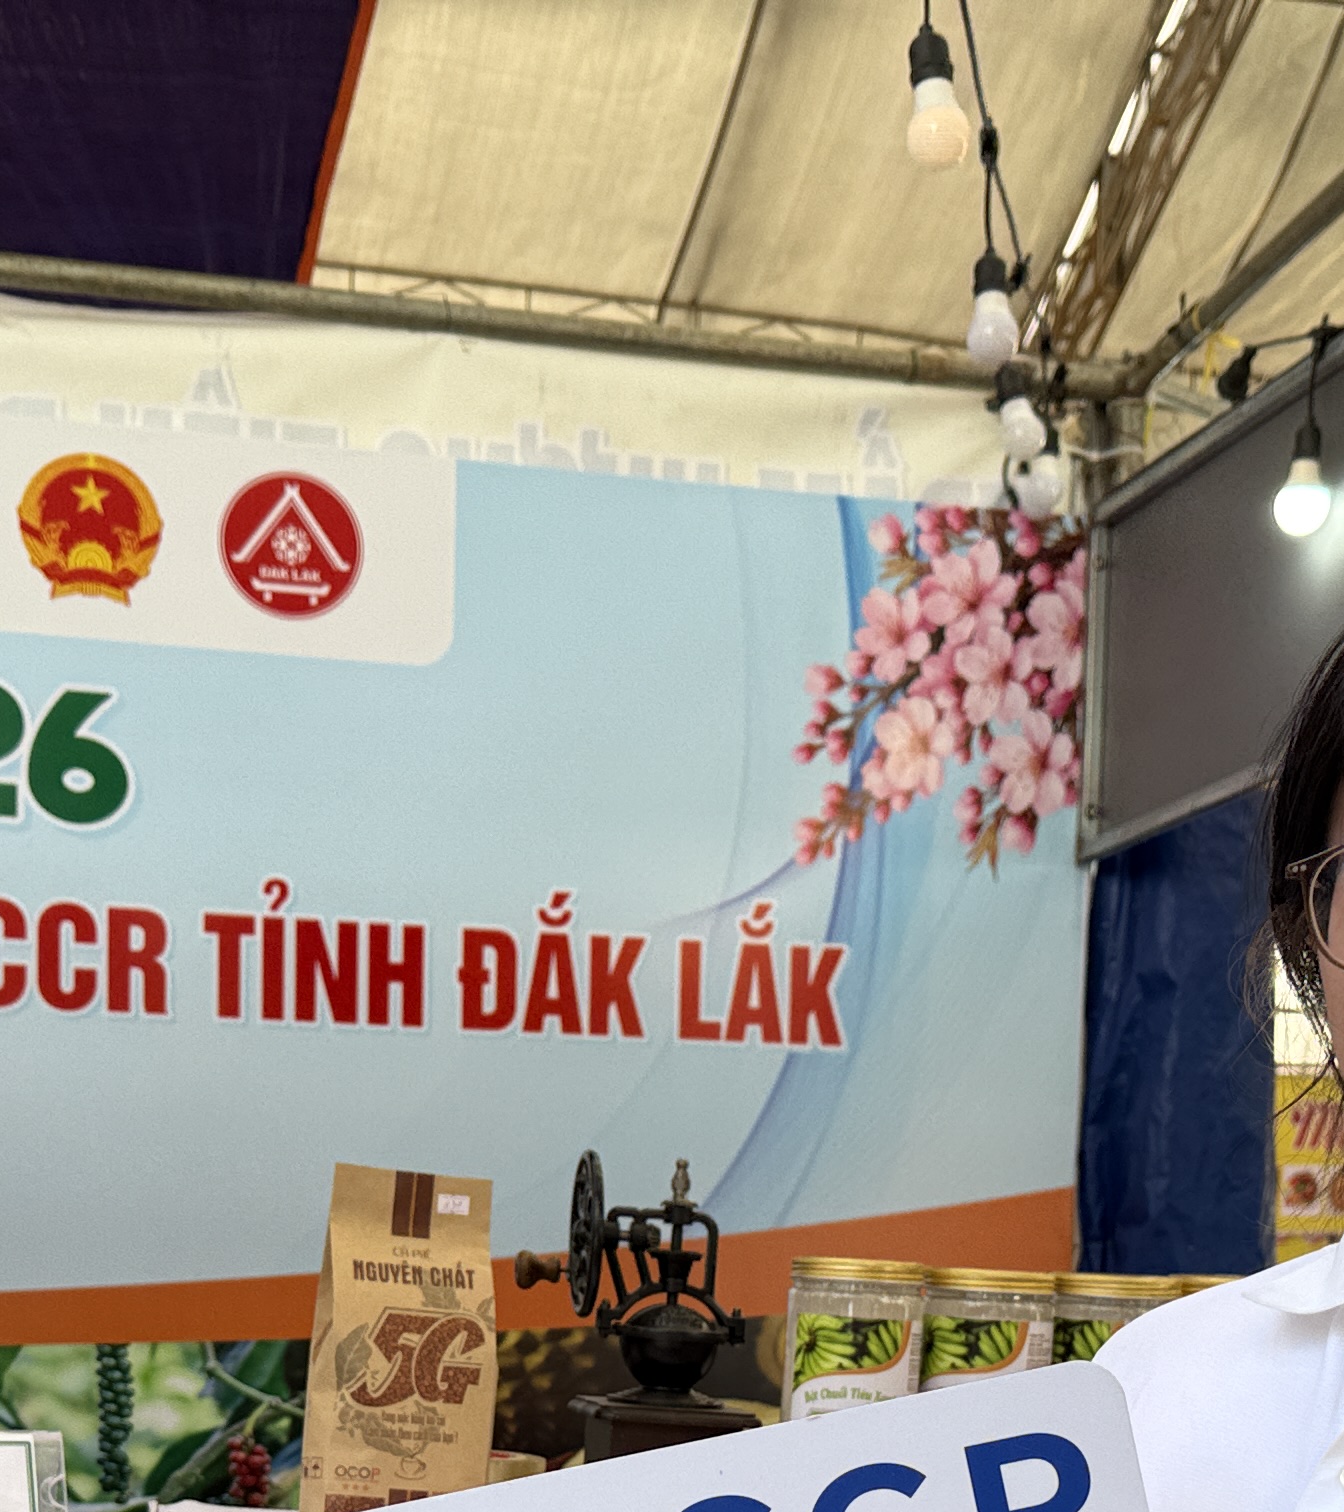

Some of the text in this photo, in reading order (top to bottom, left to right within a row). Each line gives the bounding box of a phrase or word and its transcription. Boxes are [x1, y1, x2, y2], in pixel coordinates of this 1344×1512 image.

[204, 878, 426, 1028] TỈNH
[457, 890, 646, 1038] ĐẮK
[677, 904, 846, 1049] LẮK
[344, 1306, 486, 1407] 5G
[334, 1465, 381, 1480] OCOP
